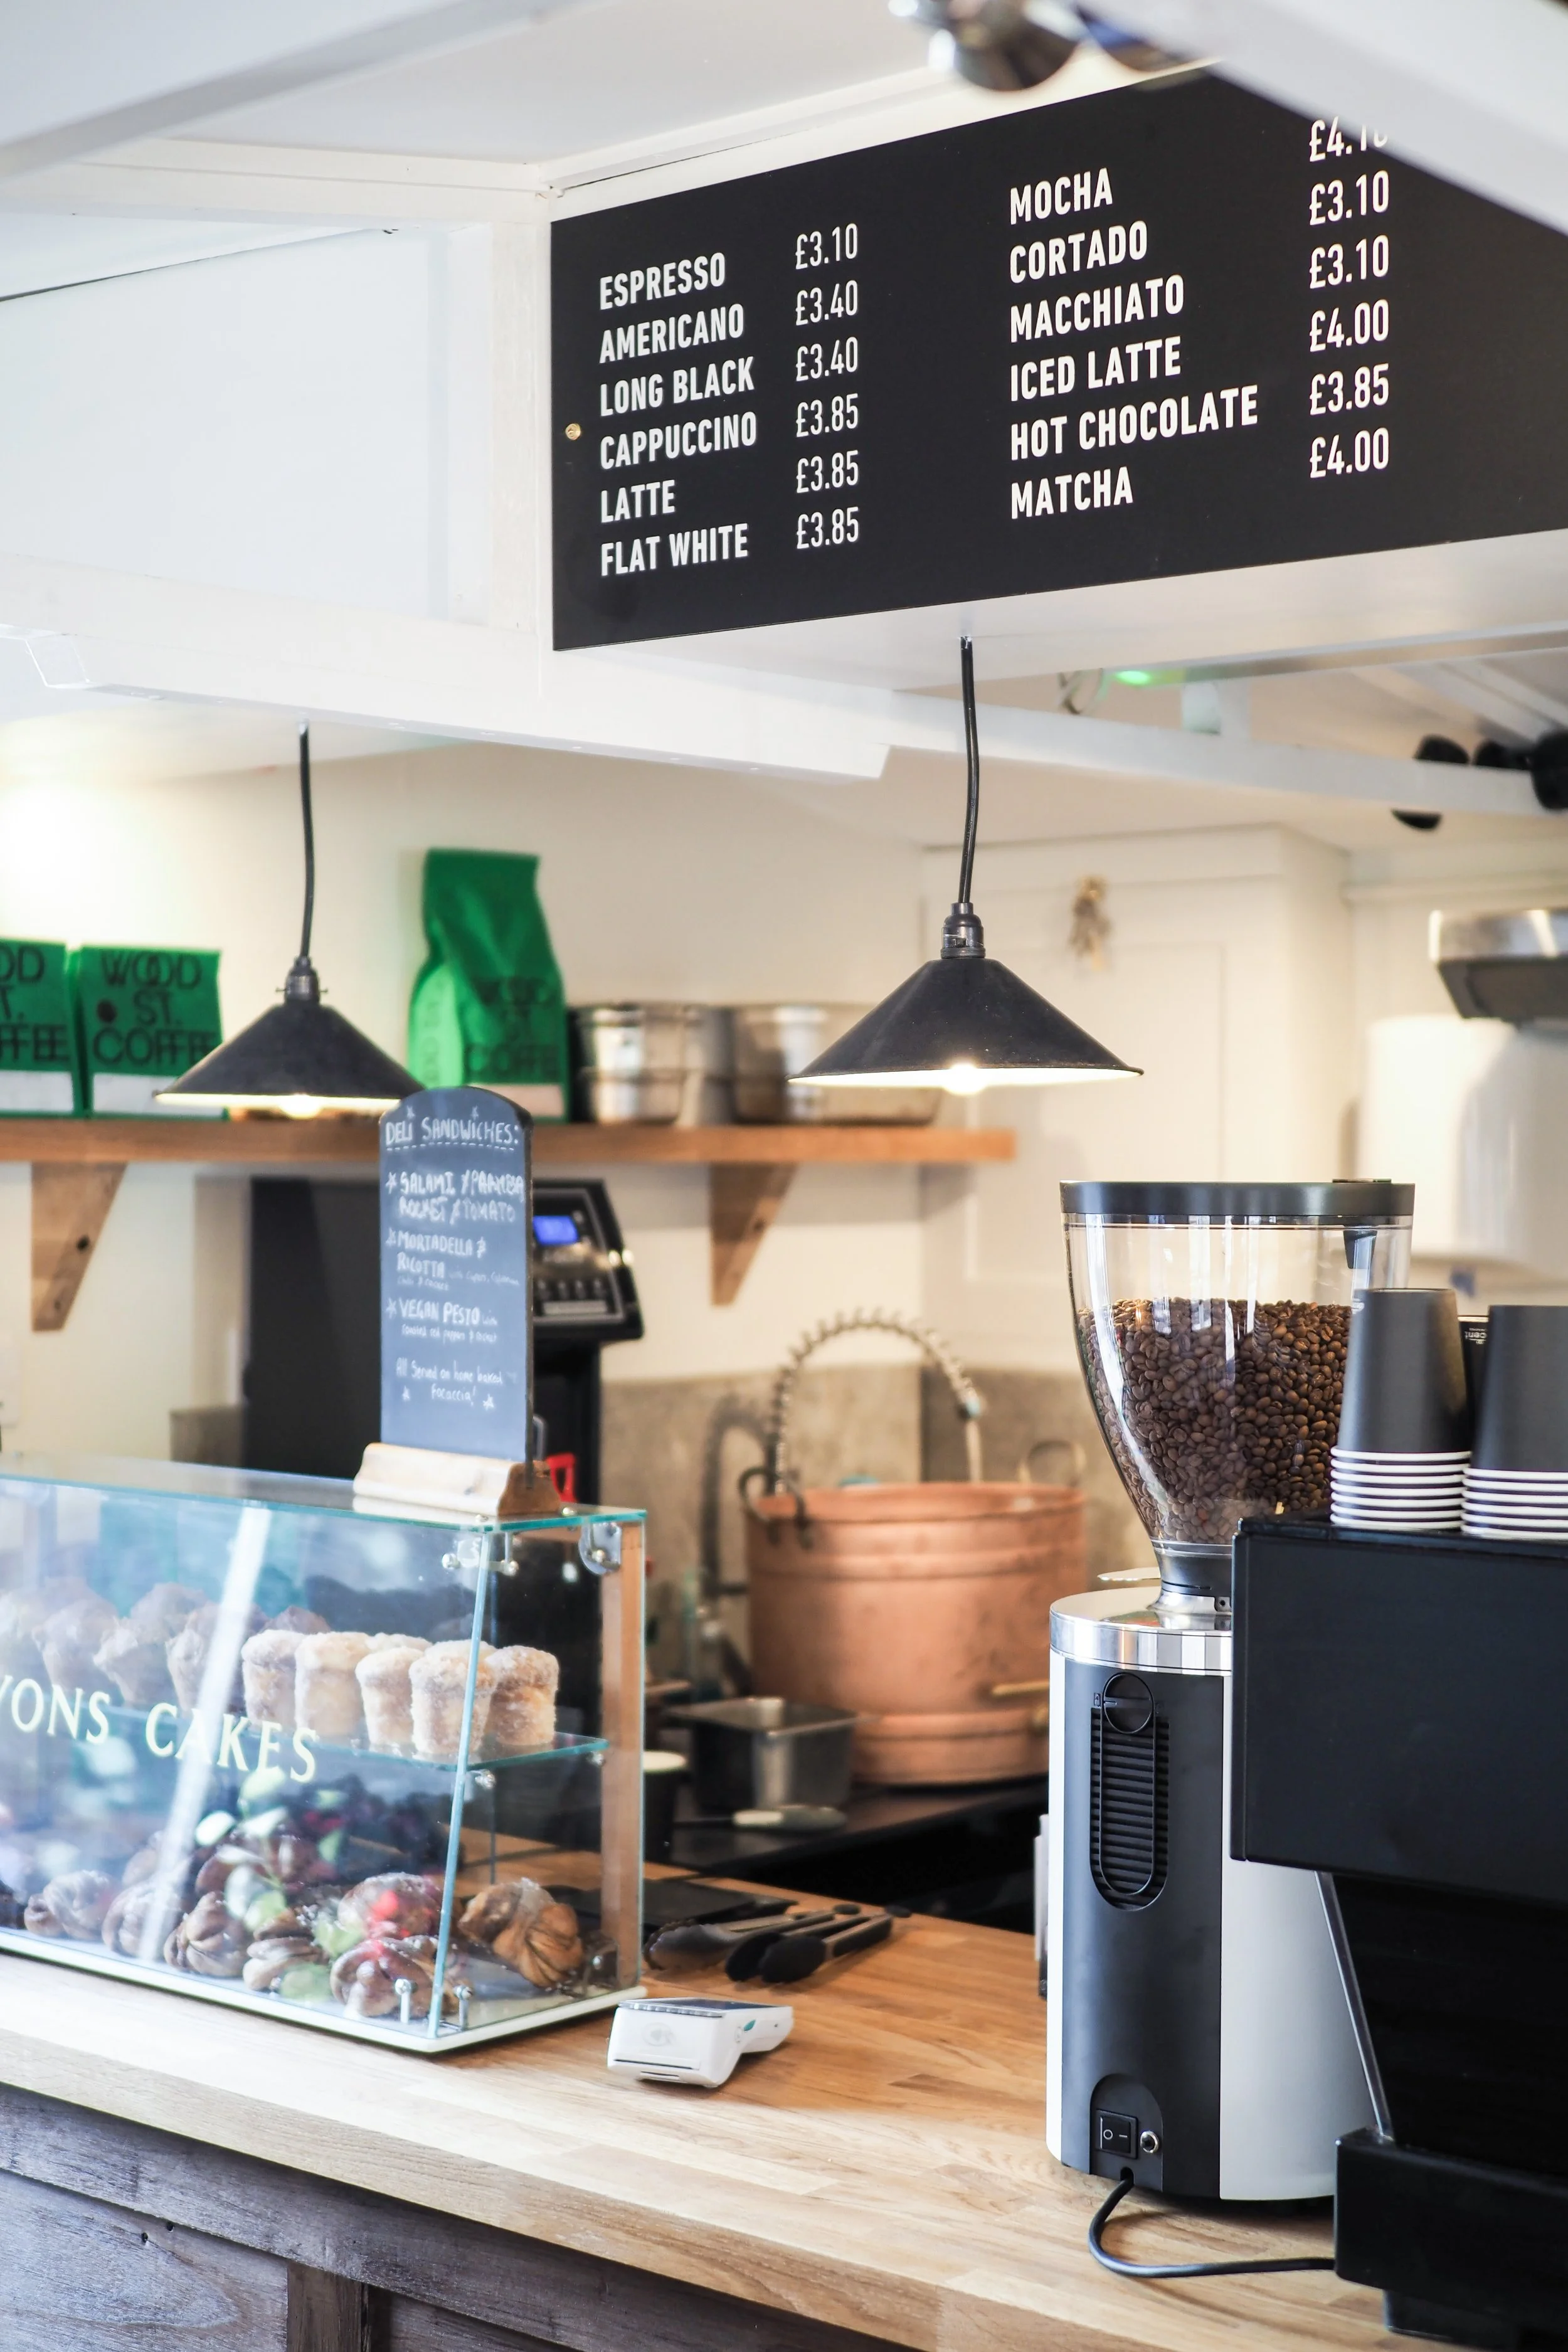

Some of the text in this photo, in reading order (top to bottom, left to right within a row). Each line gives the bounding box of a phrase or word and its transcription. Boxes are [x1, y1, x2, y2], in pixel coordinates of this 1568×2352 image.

[1010, 168, 1112, 225] MOCHA
[1010, 171, 1389, 283] CORTADO £3.10
[600, 223, 857, 310] ESPRESSO £3.10
[1011, 235, 1389, 342] MACCHIATO £3.10
[600, 280, 857, 363] AMERICANO £3.40
[1011, 299, 1389, 401] ICED LATTE £4.00
[601, 337, 857, 416] LONG BLACK £3.40
[1012, 363, 1389, 460] HOT CHOCOLATE £3.85
[601, 393, 858, 469] CAPPUCCINO £3.85
[601, 450, 858, 522] LATTE £3.85
[1012, 428, 1389, 519] MATCHA £4.00
[601, 507, 858, 576] FLAT WHITE £3.85
[400, 1171, 455, 1195] SALAMI
[462, 1197, 516, 1223] TOMATO
[396, 1251, 445, 1279] RICOTTA
[398, 1230, 473, 1256] MORTADELLA
[398, 1296, 440, 1320] VEGAN
[442, 1301, 481, 1326] PESTO
[145, 1702, 320, 1784] CAKES
